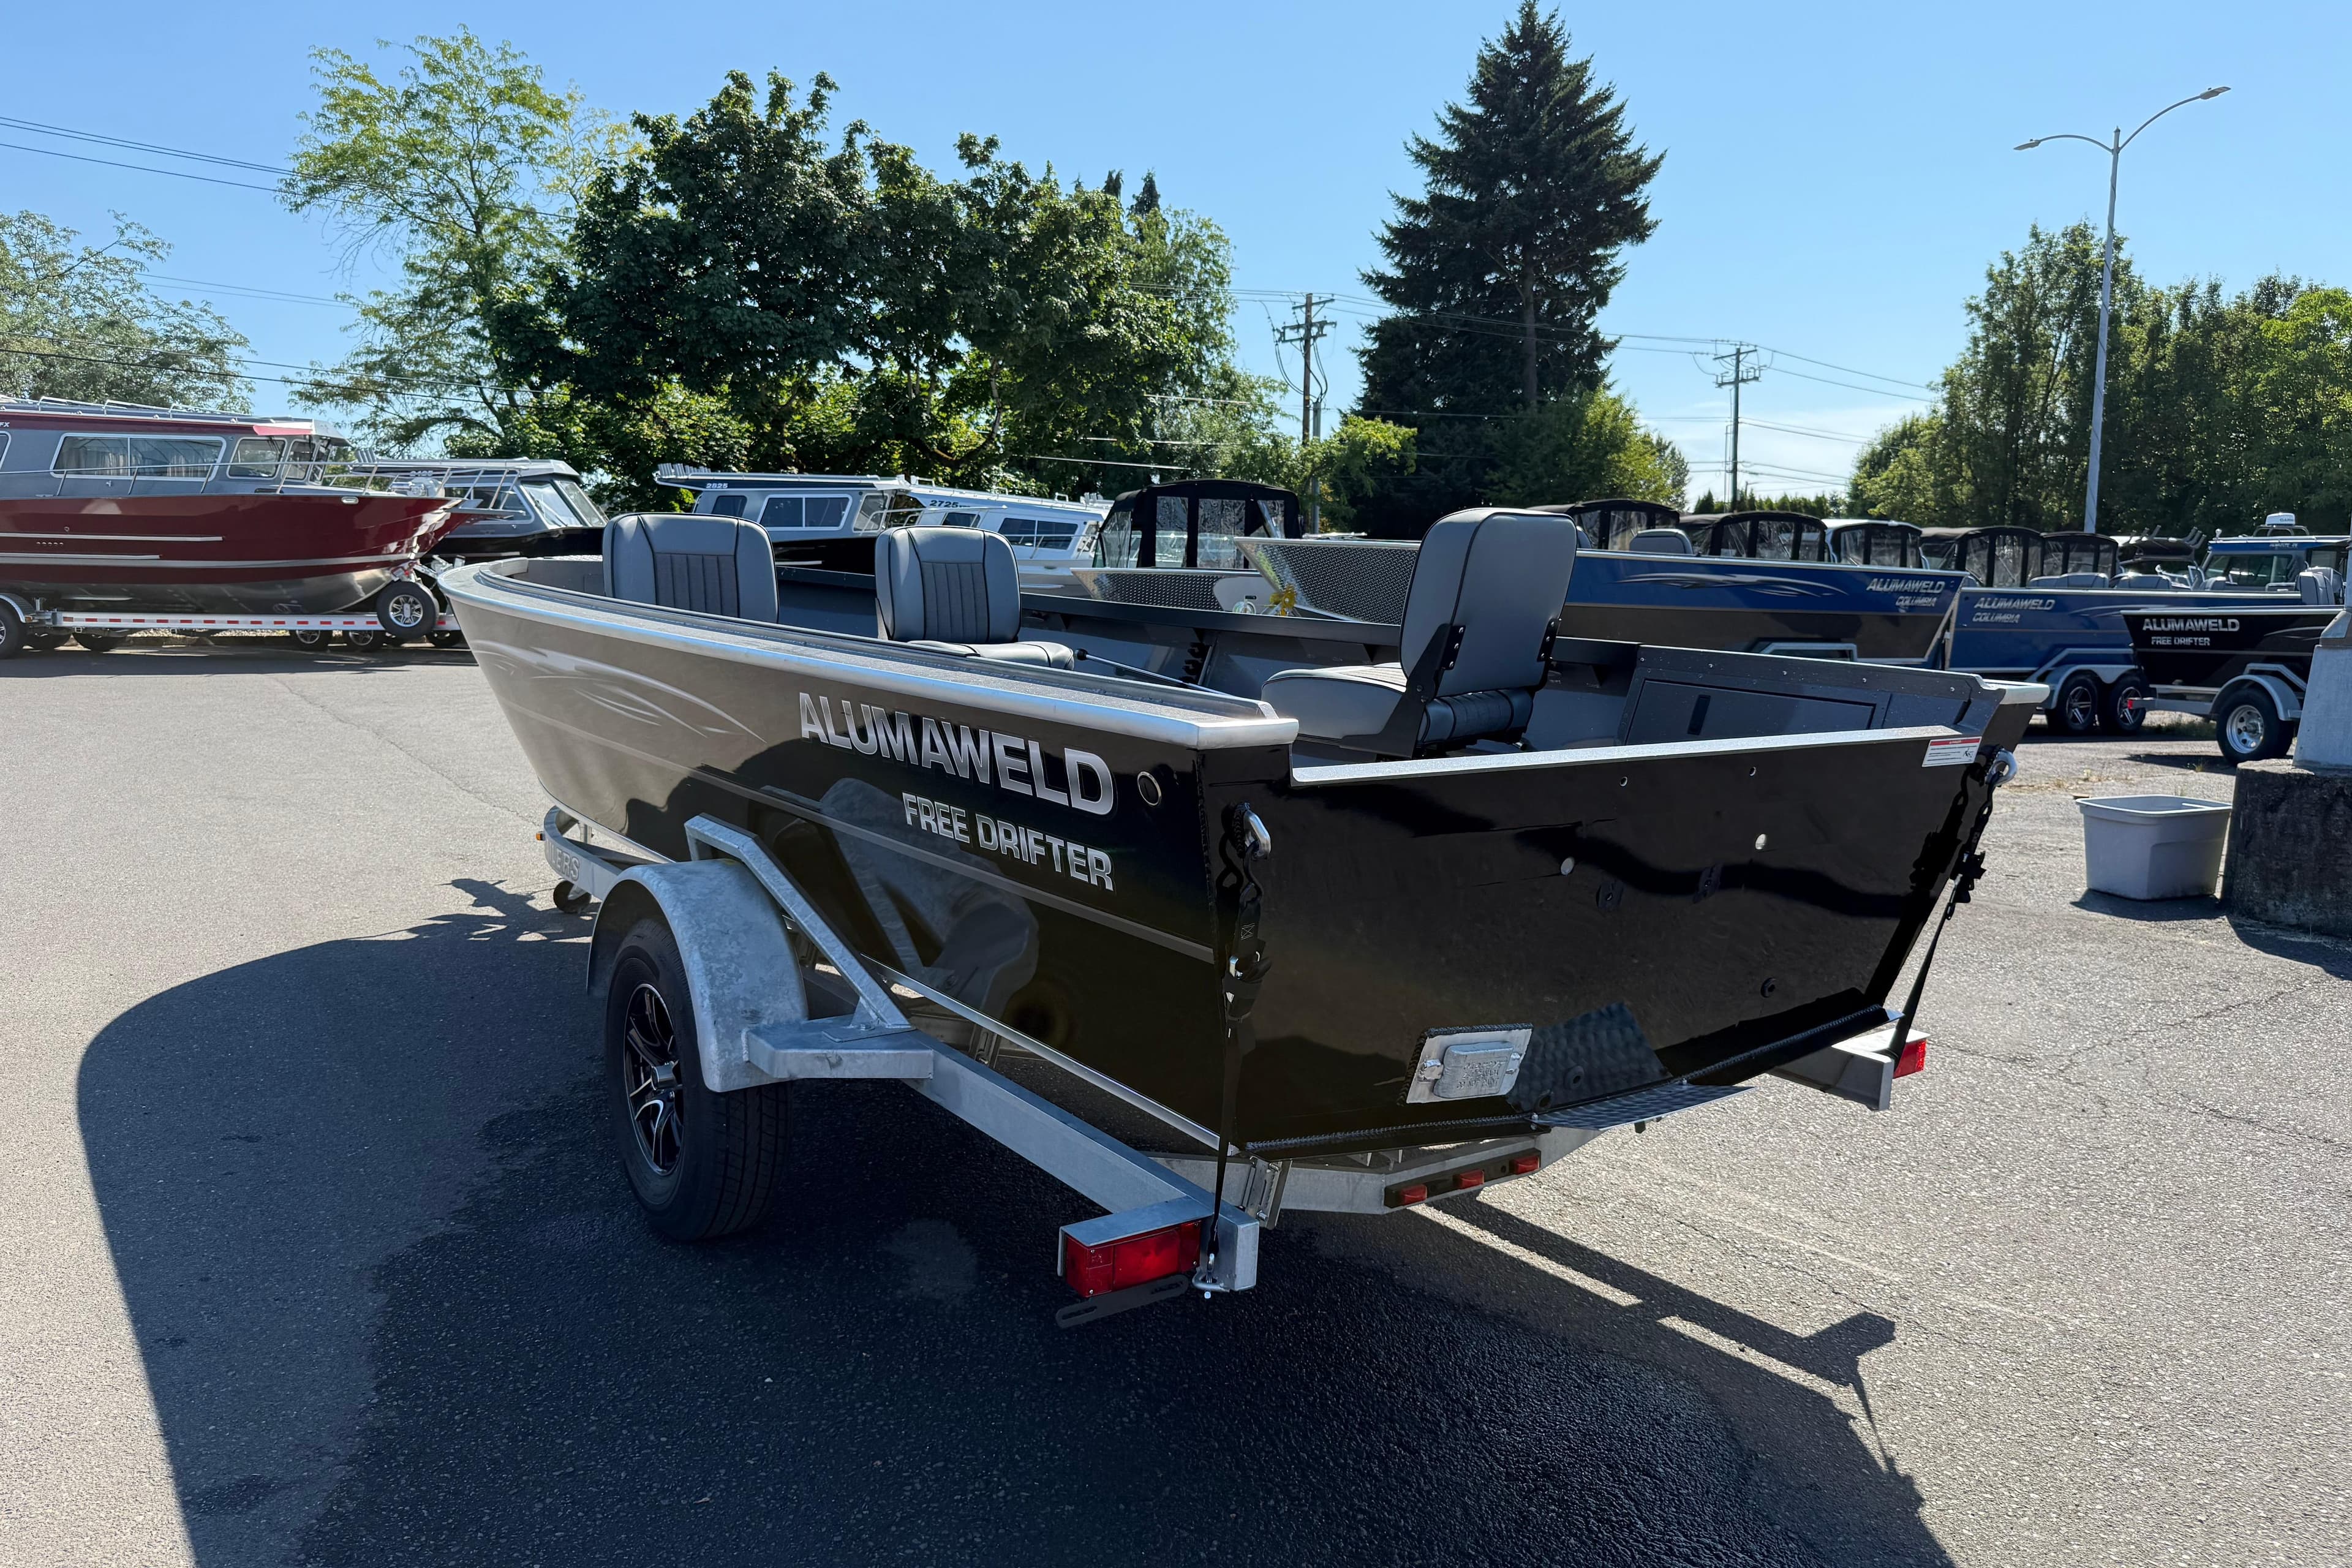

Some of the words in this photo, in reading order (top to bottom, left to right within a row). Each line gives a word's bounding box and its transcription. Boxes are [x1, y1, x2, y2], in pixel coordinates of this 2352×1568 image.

[929, 499, 959, 508] 2725
[1866, 578, 1945, 594] ALUMAWELD
[1895, 595, 1937, 607] COLUMBIA
[1974, 597, 2056, 611] ALUMAWELD
[1972, 612, 2021, 624] COLUMBIA
[2143, 618, 2240, 631] ALUMAWELD
[2151, 636, 2172, 645] FREE
[2174, 637, 2211, 646] DRIFTER
[799, 692, 1114, 816] ALUMAWELD
[902, 792, 970, 844] FREE
[976, 813, 1114, 892] DRIFTER
